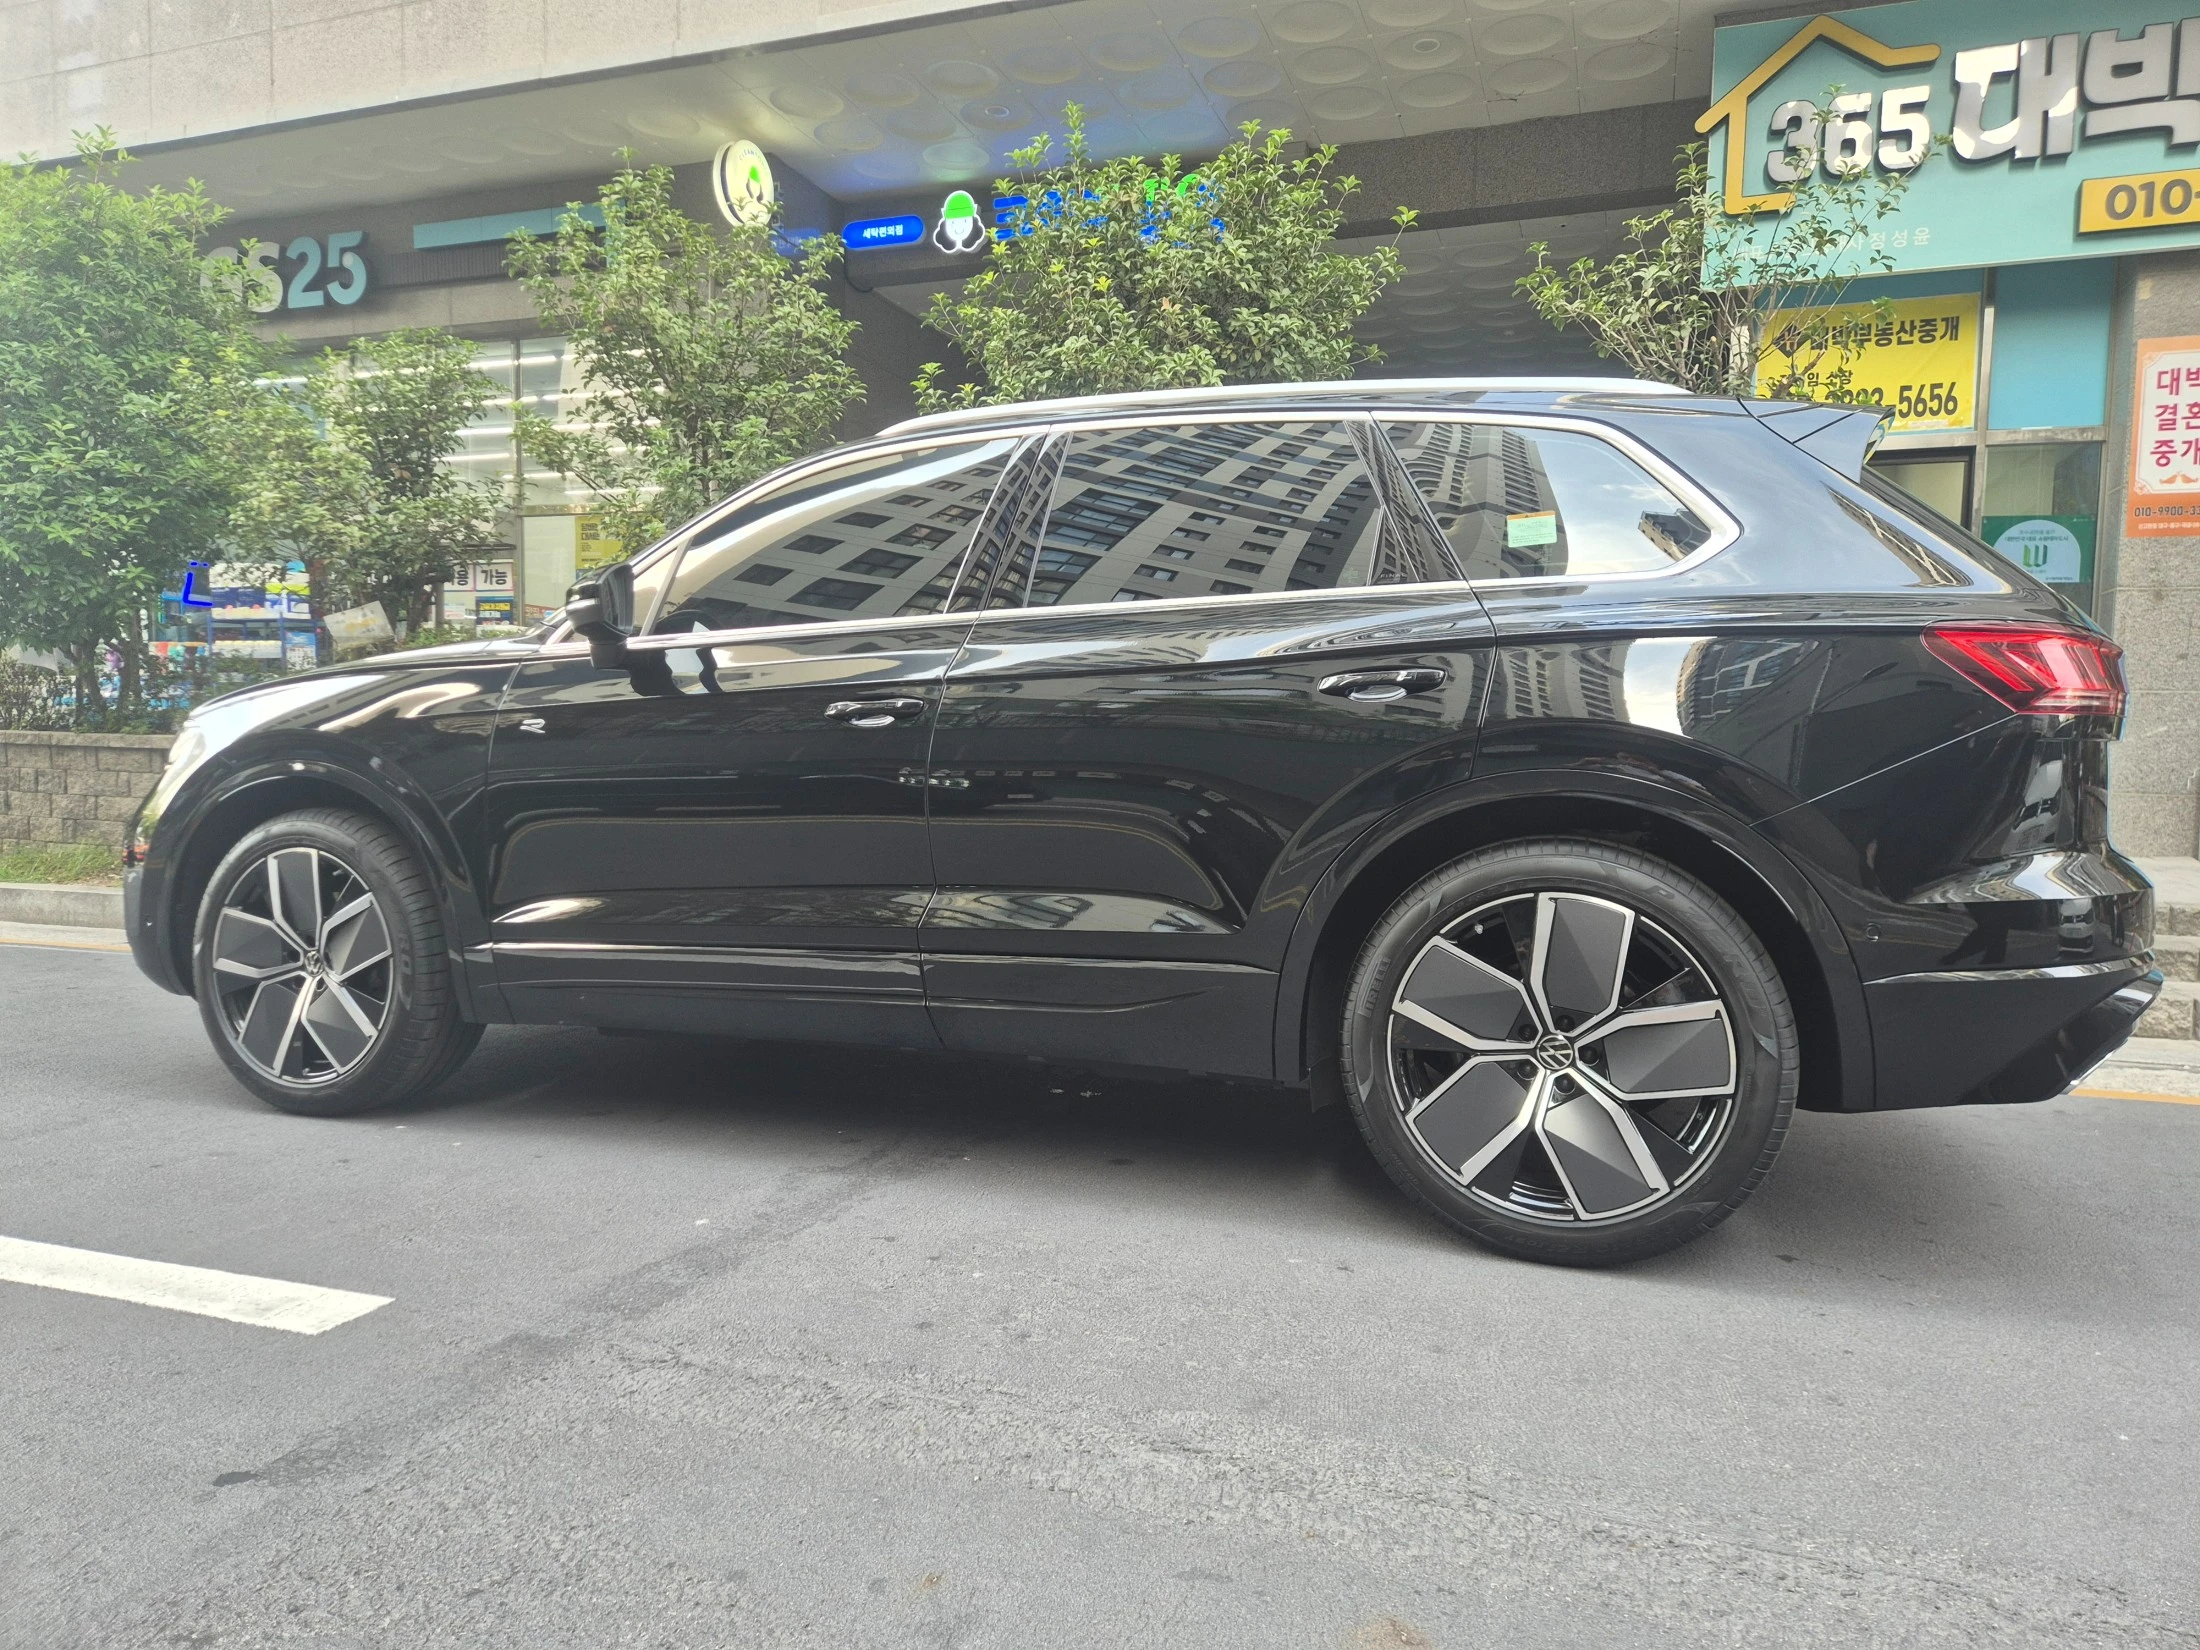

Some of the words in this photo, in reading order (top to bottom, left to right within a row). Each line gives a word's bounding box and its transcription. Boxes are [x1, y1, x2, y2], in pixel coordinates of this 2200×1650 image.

[1767, 85, 1930, 182] 365
[481, 569, 508, 586] 가능
[519, 718, 546, 734] R
